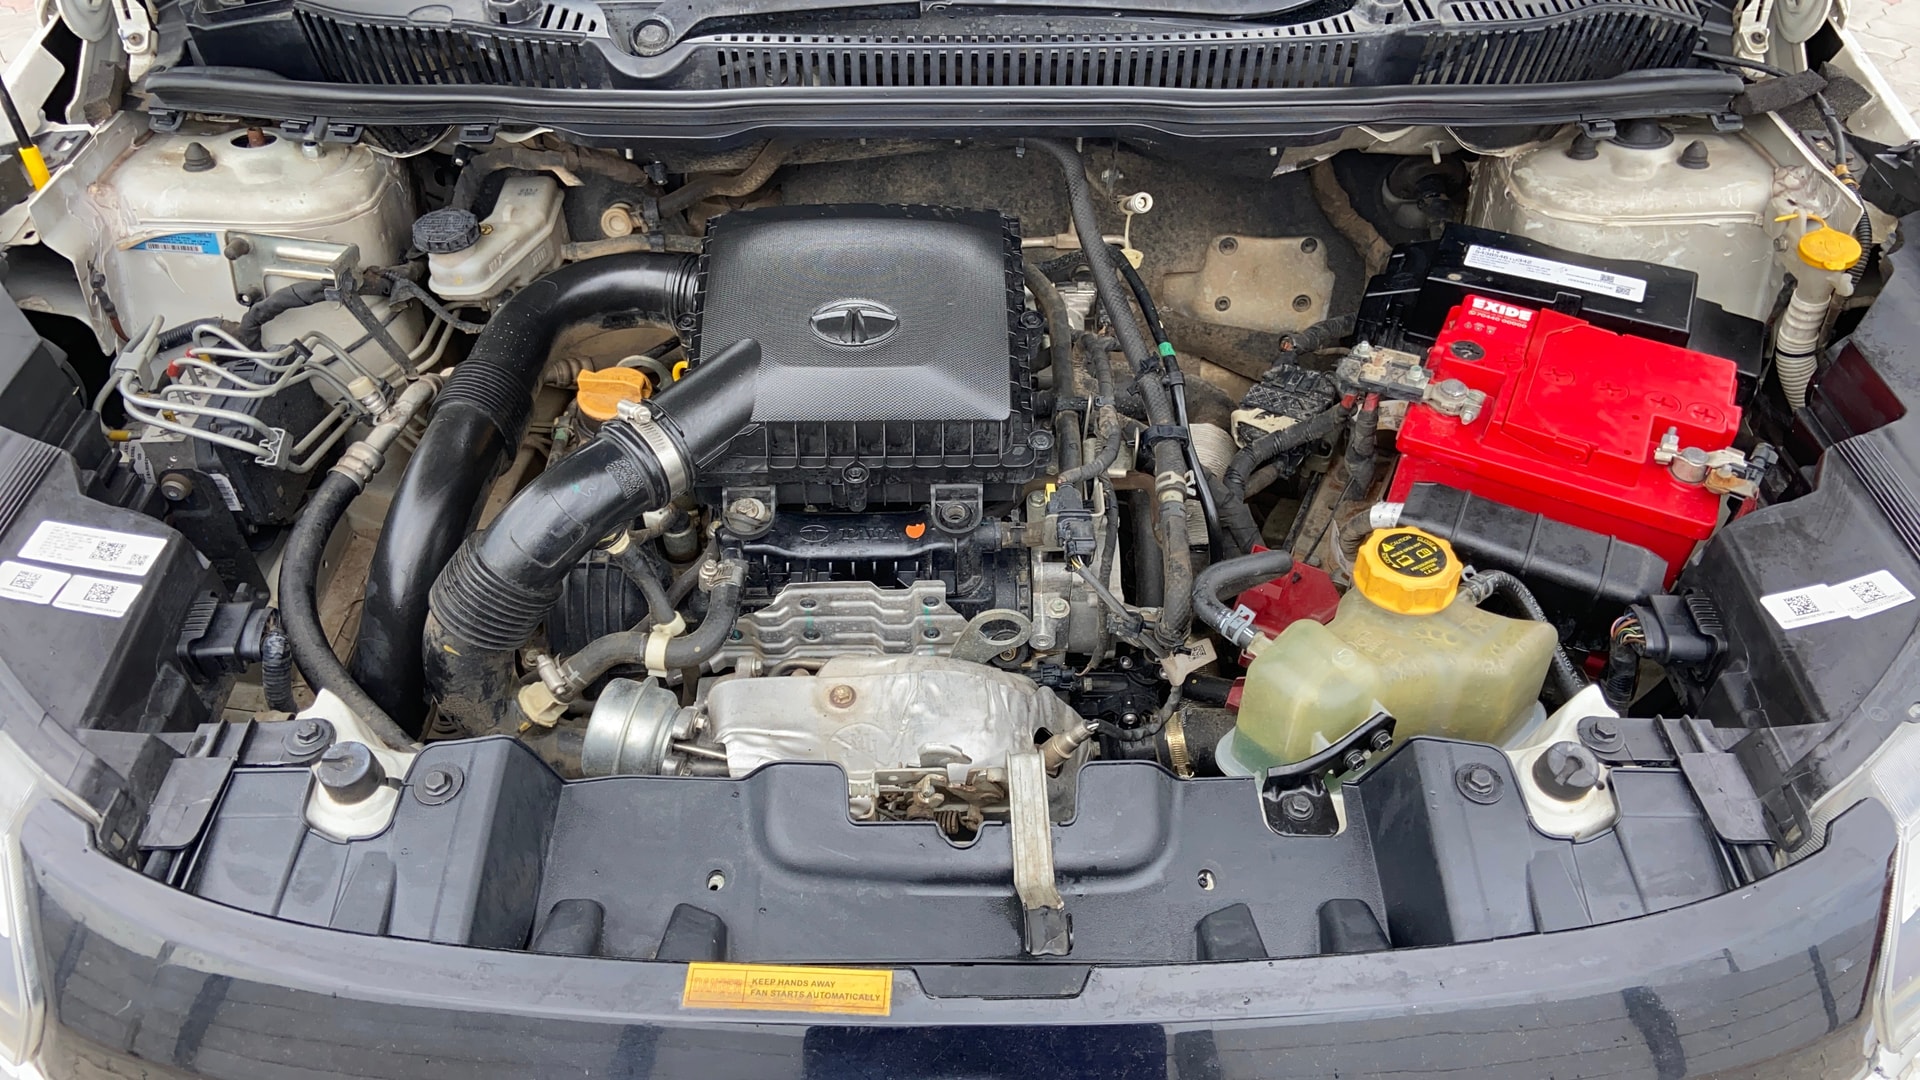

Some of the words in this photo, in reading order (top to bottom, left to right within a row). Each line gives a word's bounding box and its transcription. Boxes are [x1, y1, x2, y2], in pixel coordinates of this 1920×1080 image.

[1472, 298, 1533, 322] EXIDE
[1477, 312, 1500, 322] 70440
[1501, 319, 1528, 329] 00000
[1390, 535, 1412, 547] CAUTION
[751, 978, 776, 987] KEEP
[777, 979, 809, 988] HANDS
[810, 980, 836, 988] AWAY
[750, 989, 768, 998] FAN
[769, 990, 804, 999] STARTS
[806, 991, 881, 1002] AUTOMATICALLY
